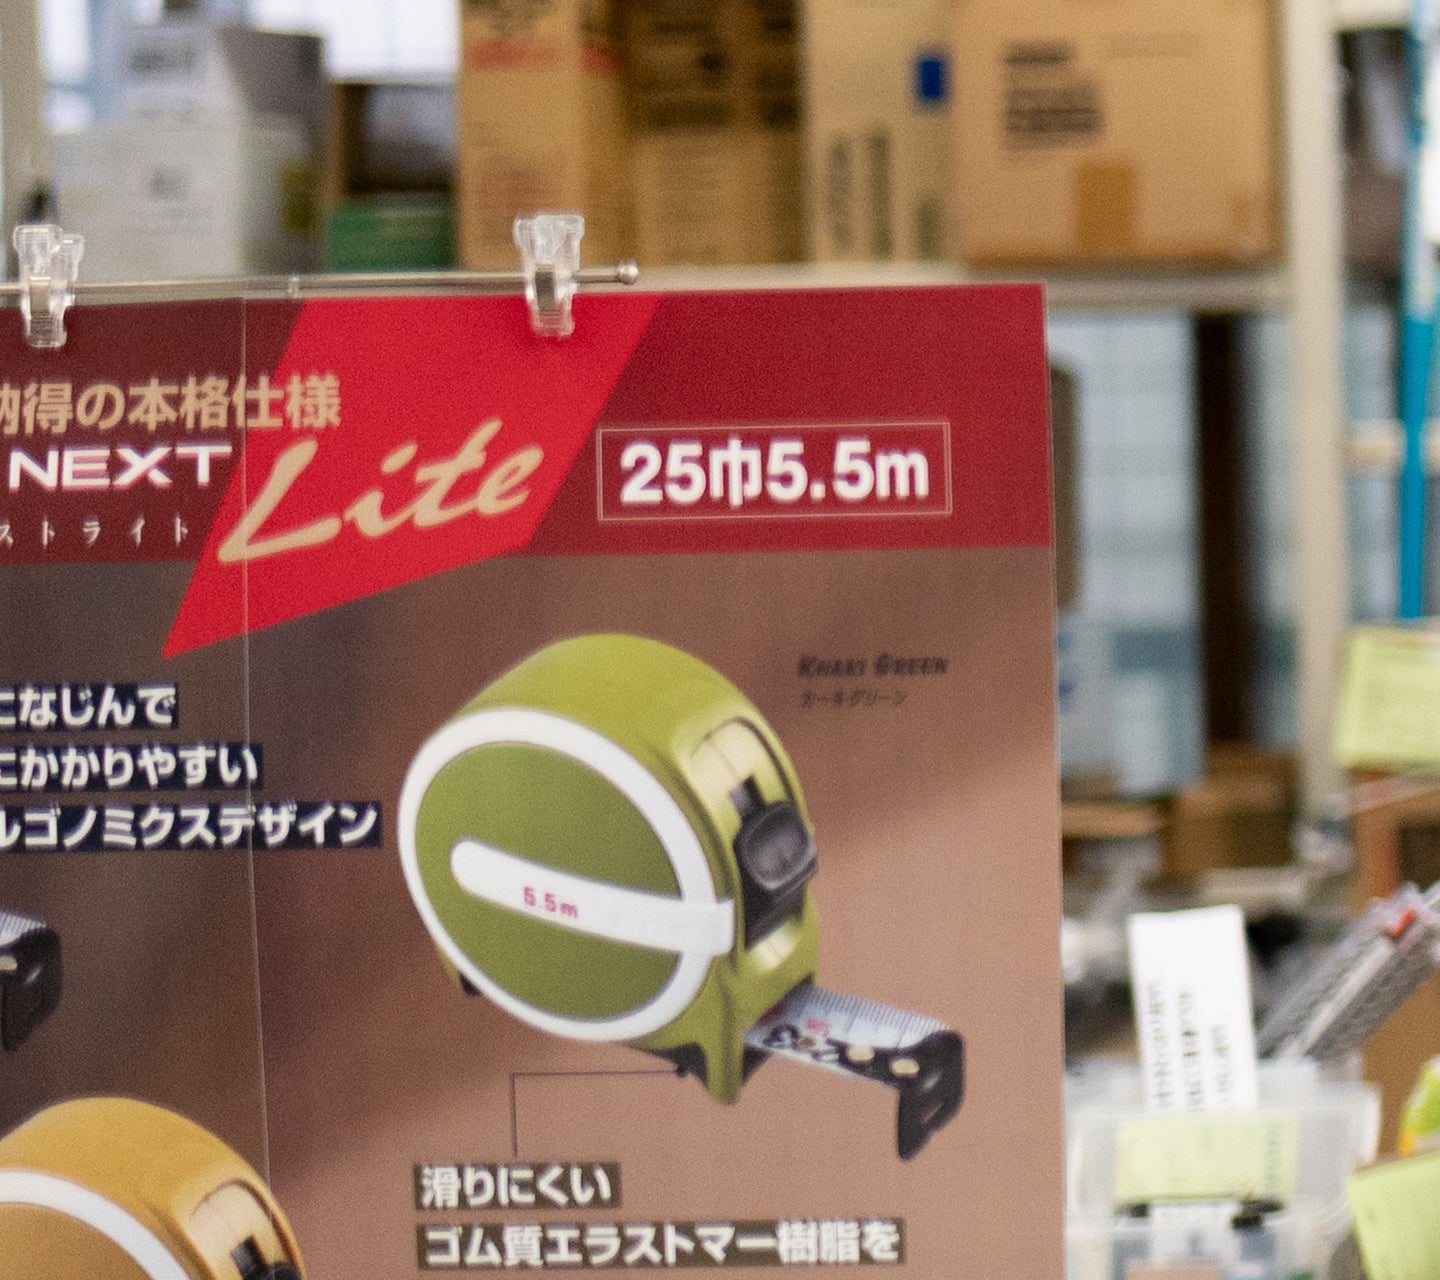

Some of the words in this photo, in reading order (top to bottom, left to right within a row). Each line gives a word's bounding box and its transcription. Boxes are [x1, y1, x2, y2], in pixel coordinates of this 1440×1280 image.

[8, 442, 233, 491] NEXT
[216, 419, 544, 563] Lite
[618, 438, 931, 509] 25巾5.5m
[421, 1166, 612, 1208] 滑りにくい
[425, 1224, 899, 1266] ゴム質エラストマー樹脂を
